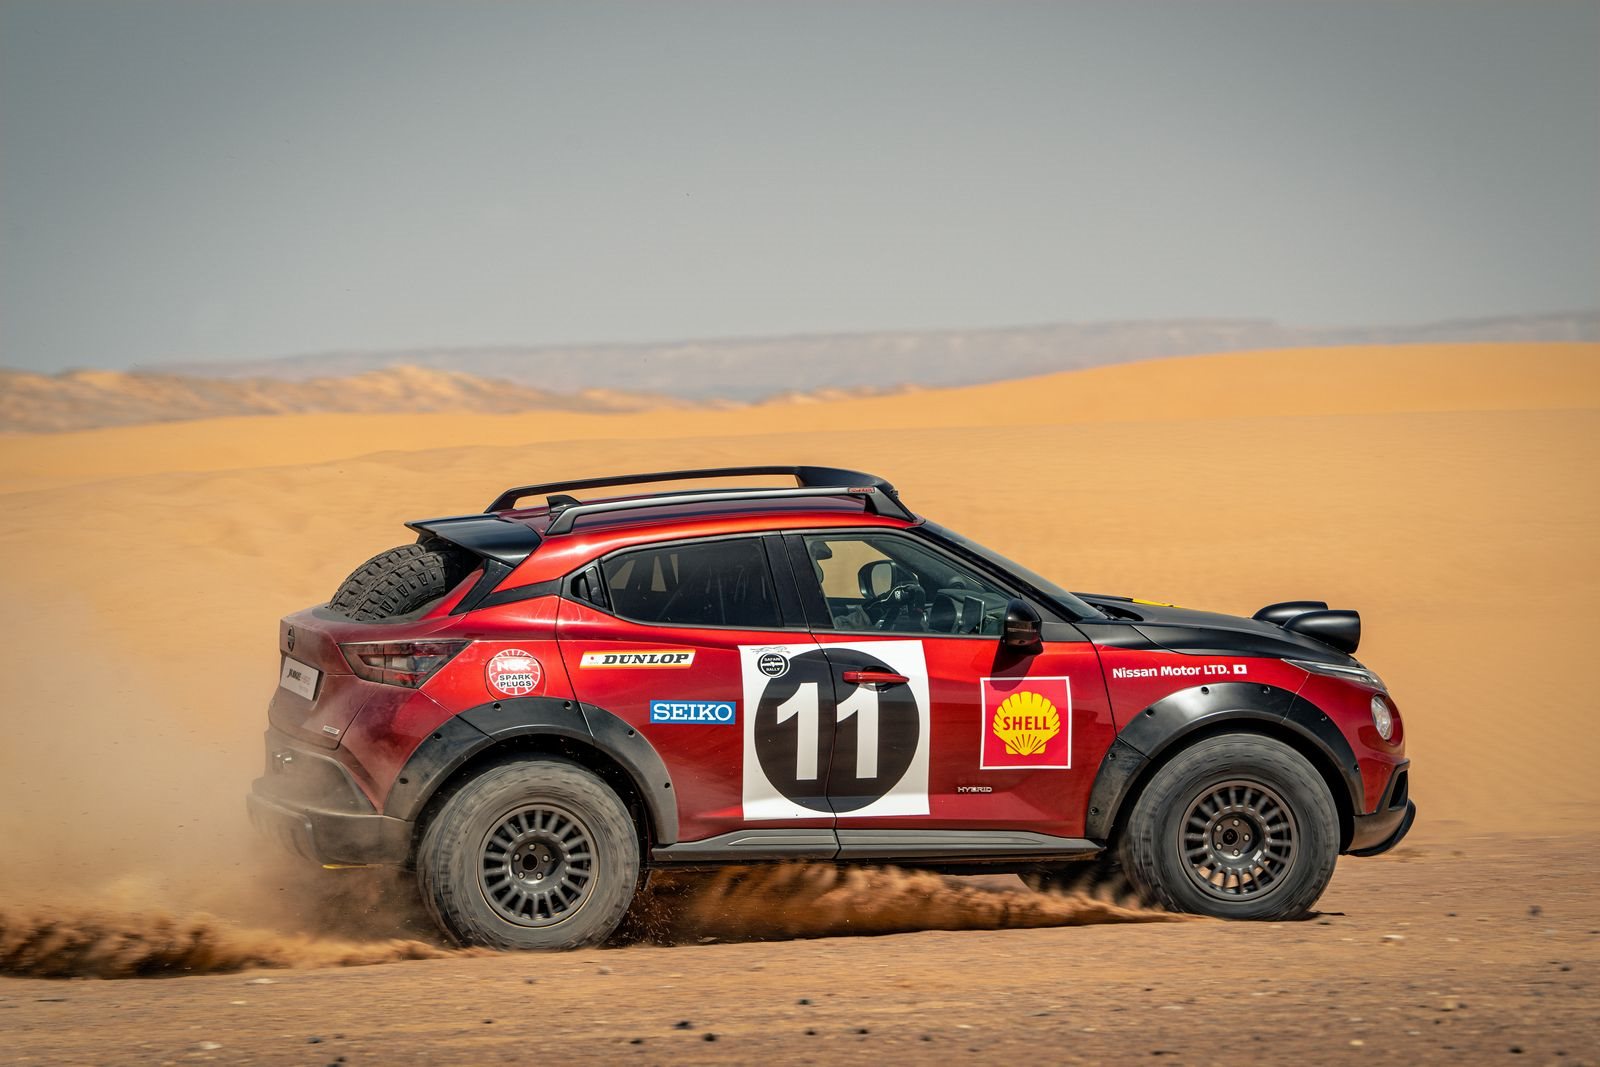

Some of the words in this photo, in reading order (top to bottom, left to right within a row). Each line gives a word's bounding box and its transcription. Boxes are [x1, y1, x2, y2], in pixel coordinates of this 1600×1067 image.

[602, 653, 689, 664] DUNLOP
[1112, 667, 1158, 679] Nissan
[1160, 665, 1201, 677] Motor
[1203, 664, 1230, 675] LTD.
[653, 703, 733, 722] SEIKO
[1002, 716, 1051, 731] SHELL
[776, 682, 879, 781] 11
